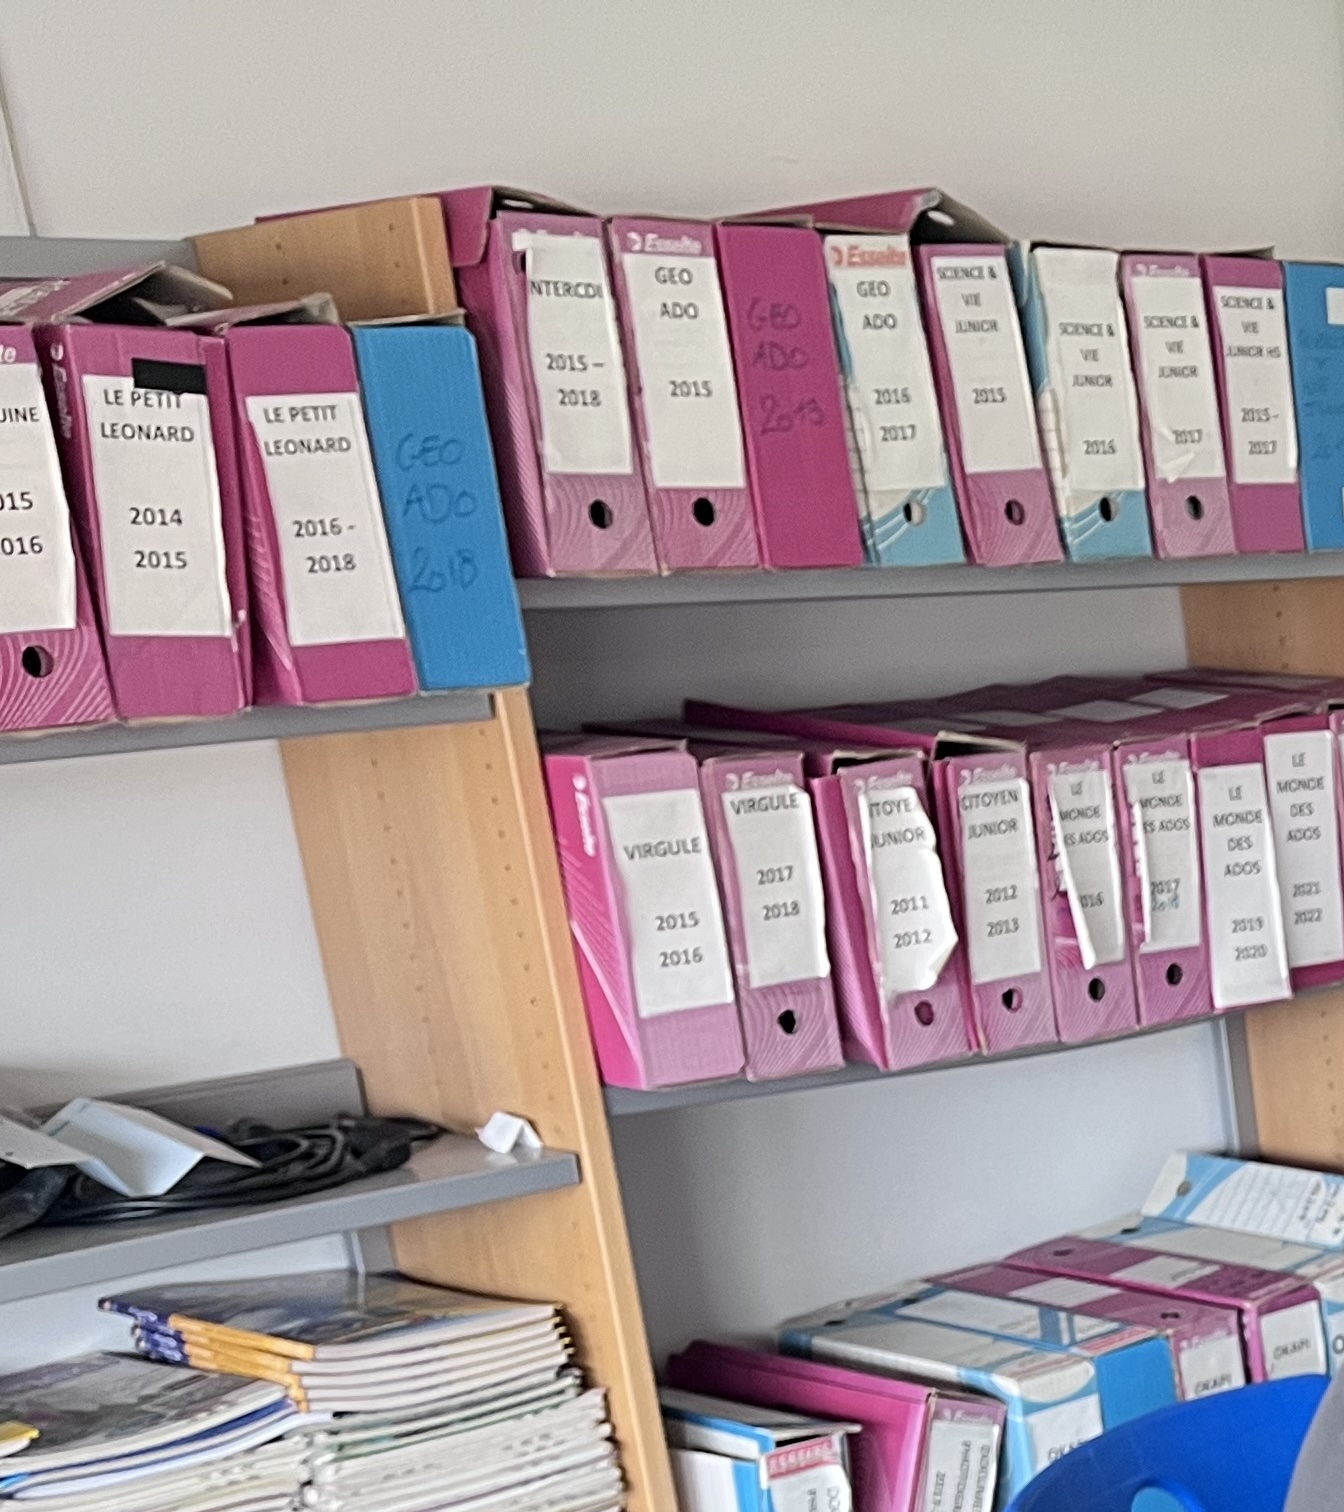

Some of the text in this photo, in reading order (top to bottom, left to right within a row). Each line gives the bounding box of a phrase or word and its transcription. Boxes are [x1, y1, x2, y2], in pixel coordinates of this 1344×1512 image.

[654, 266, 693, 286] GEO
[936, 266, 984, 281] SCIENCE
[856, 280, 892, 298] GEO
[960, 293, 982, 307] VIE
[1219, 295, 1263, 310] SCIENCE
[660, 302, 699, 321] ADO
[862, 313, 898, 330] ADO
[955, 319, 999, 334] JUNIOR
[1058, 322, 1104, 338] SCIENCE
[1143, 315, 1189, 330] SCIENCE
[545, 353, 588, 372] 2015
[1158, 365, 1199, 379] JUNIOR
[669, 380, 713, 398] 2015
[1072, 374, 1114, 389] JUNIOR
[103, 388, 181, 409] LE PETIT
[557, 388, 602, 408] 2018
[263, 404, 337, 424] LE PETIT
[100, 421, 195, 443] LEONARD
[879, 424, 917, 442] 2017
[263, 436, 351, 457] LEONARD
[396, 433, 463, 473] GEO
[404, 483, 478, 524] ADO
[129, 506, 183, 526] 2014
[292, 517, 343, 538] 2016
[0, 535, 43, 556] 016
[134, 550, 188, 570] 2015
[306, 553, 357, 574] 2018
[1276, 776, 1325, 794] MONDE
[729, 792, 801, 817] VIRGULE
[960, 790, 1019, 812] CITOYEN
[1289, 802, 1315, 818] DES
[1212, 809, 1264, 827] MONDE
[870, 828, 926, 850] JUNIOR
[967, 818, 1018, 841] JUNIOR
[1286, 827, 1322, 842] ADOS
[623, 836, 701, 861] VIRGULE
[1227, 836, 1254, 852] DES
[756, 865, 794, 886] 2017
[1223, 861, 1262, 877] ADOS
[985, 884, 1019, 905] 2012
[890, 896, 929, 916] 2011
[655, 911, 700, 933] 2015
[893, 928, 933, 949] 2012
[659, 946, 704, 968] 2016
